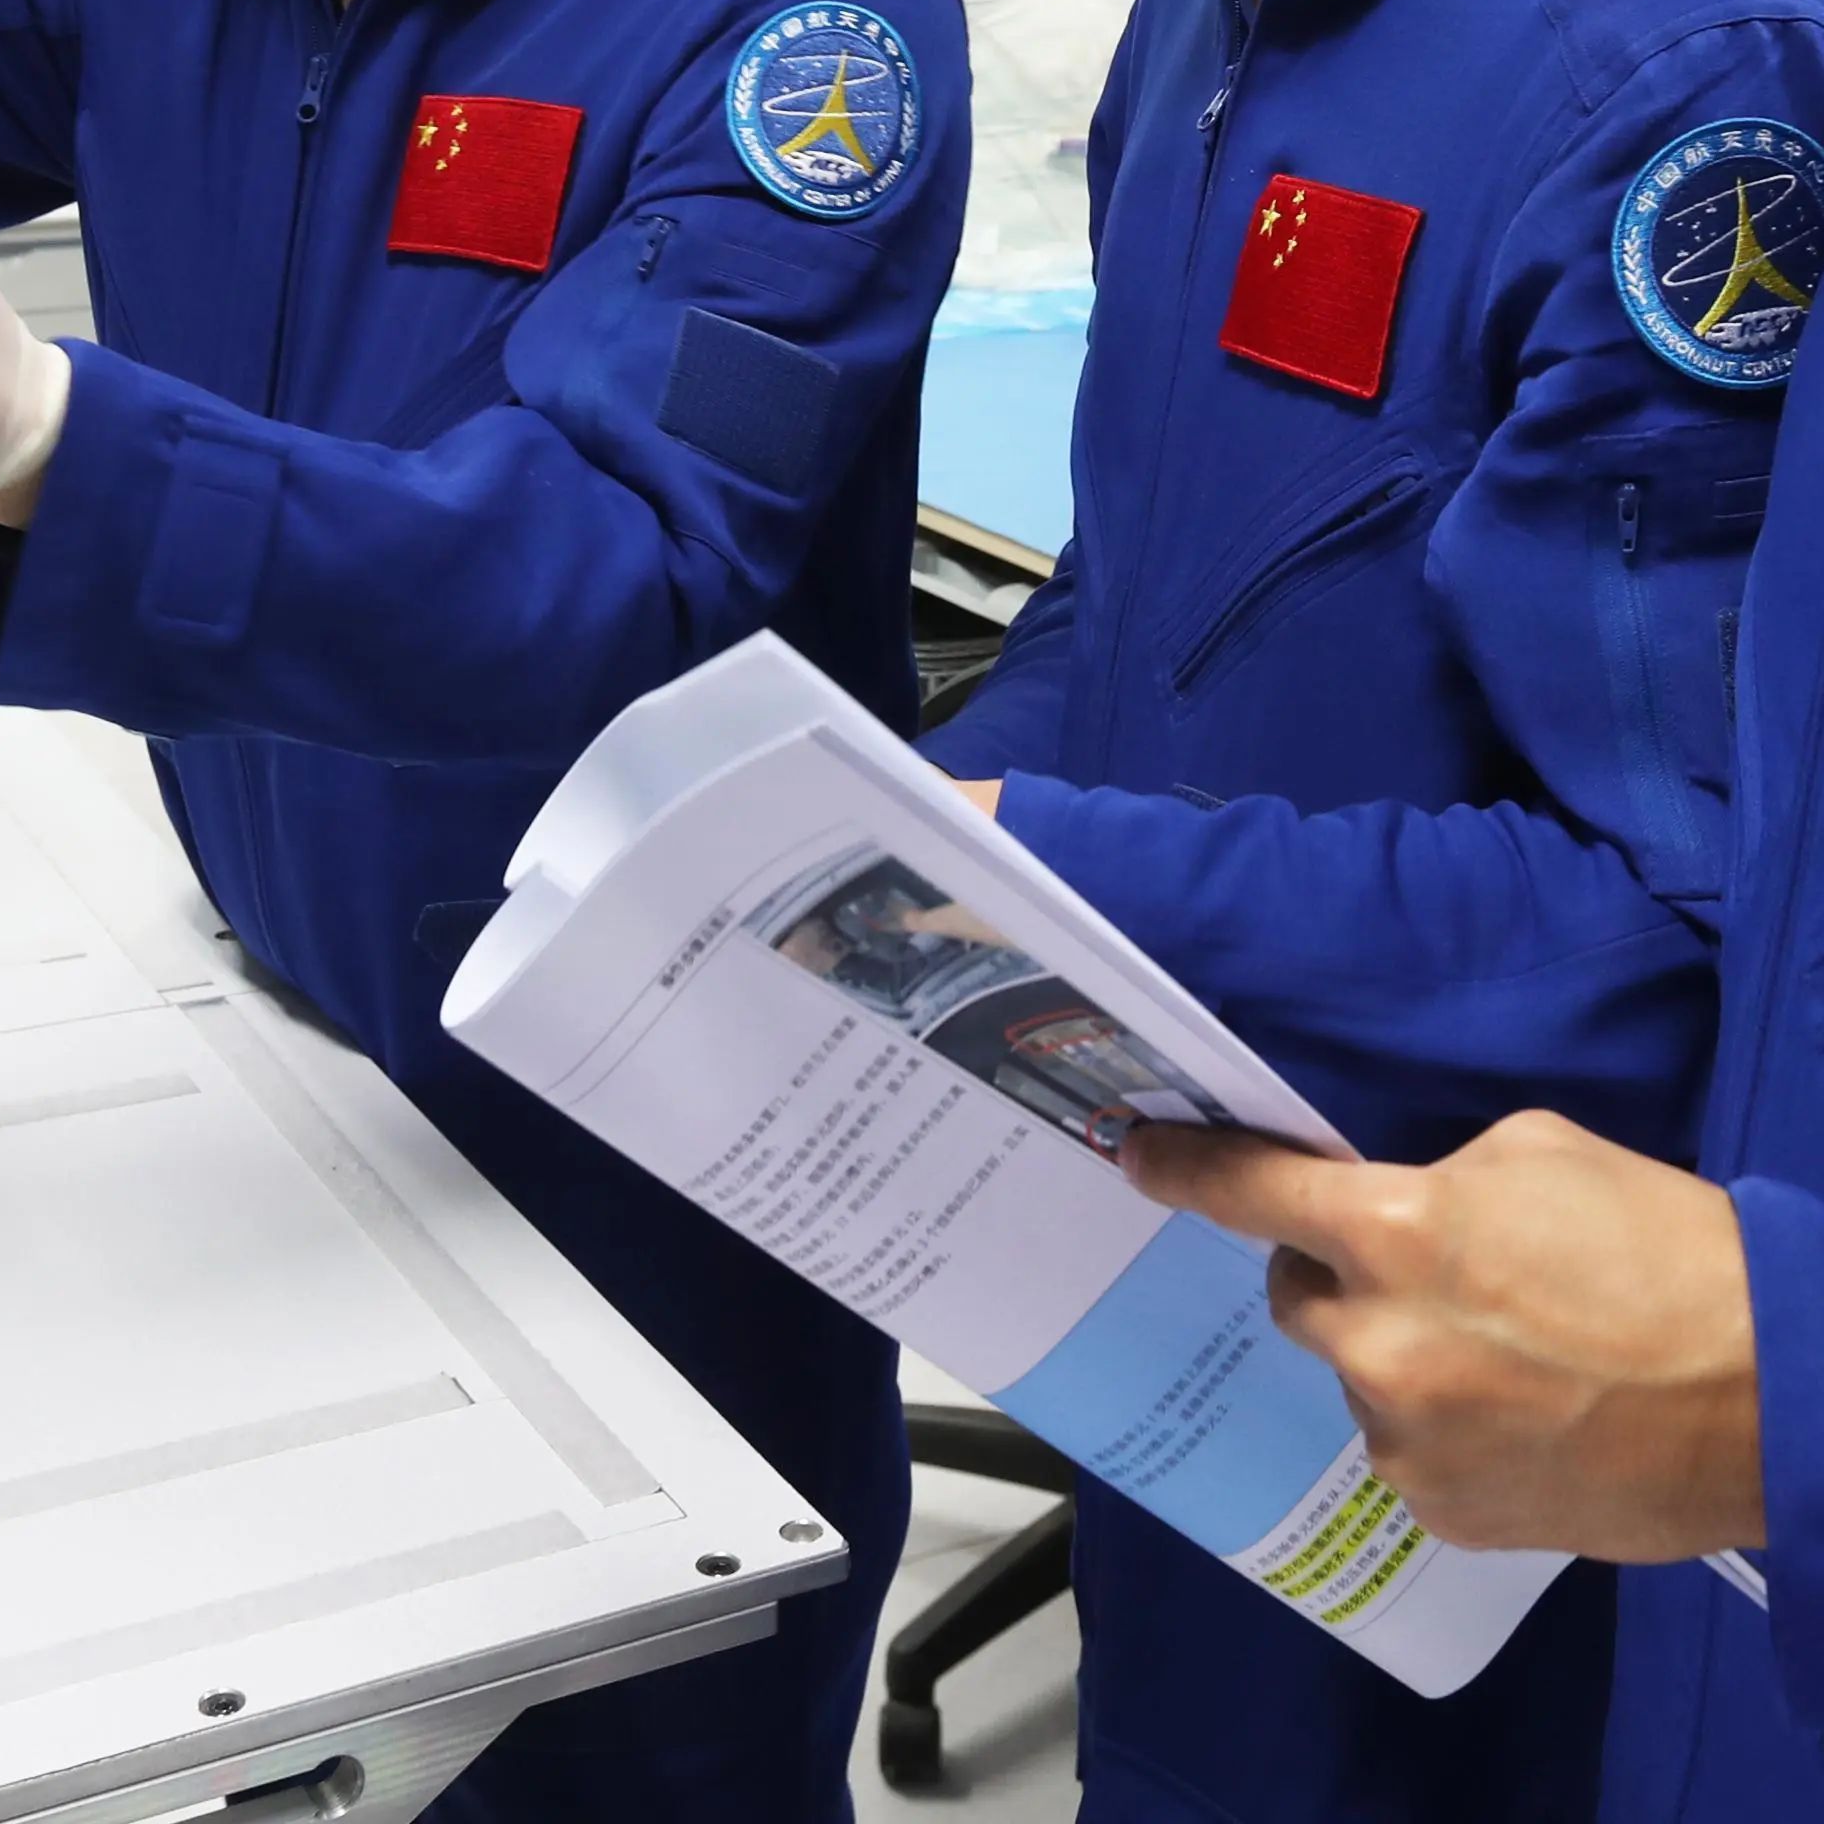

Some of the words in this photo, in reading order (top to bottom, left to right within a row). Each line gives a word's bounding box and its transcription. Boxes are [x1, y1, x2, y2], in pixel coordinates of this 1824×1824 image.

[760, 10, 912, 85] 中国航天员中心
[738, 126, 801, 196] ASTRONAUT
[802, 187, 853, 208] CENTER
[874, 159, 905, 193] CHINA
[1643, 310, 1737, 375] ASTRONAUT
[1741, 348, 1797, 377] CENTE
